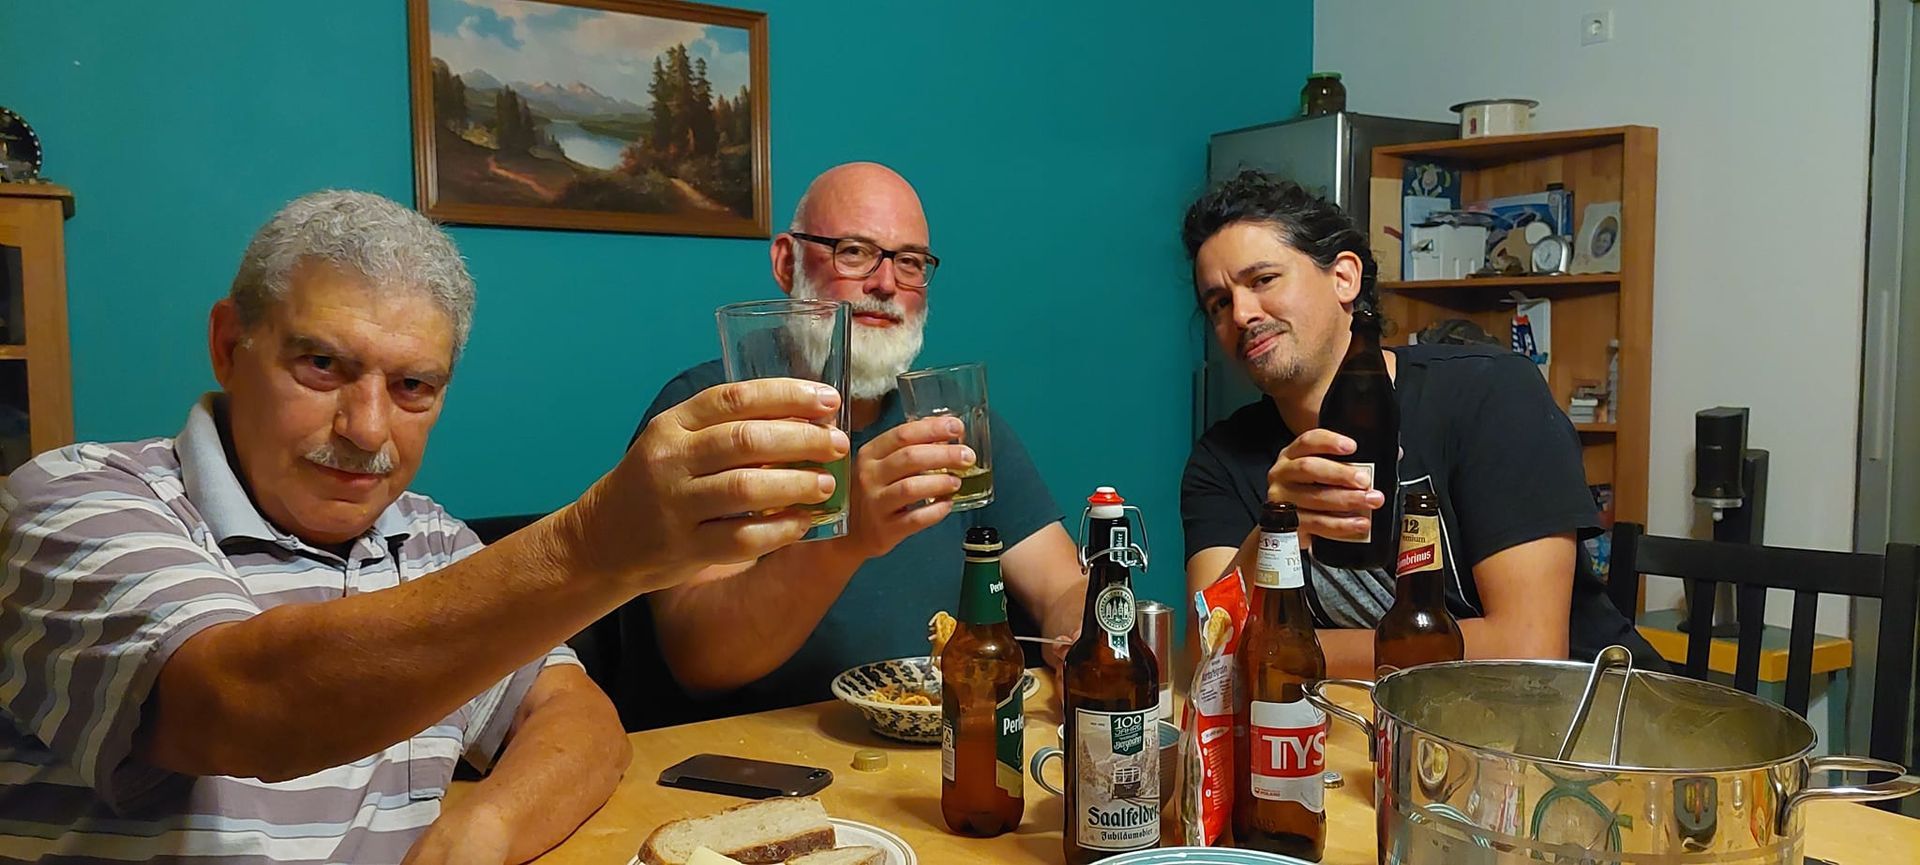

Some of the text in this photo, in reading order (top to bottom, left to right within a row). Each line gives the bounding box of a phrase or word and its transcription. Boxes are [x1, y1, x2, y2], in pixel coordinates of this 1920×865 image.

[1403, 518, 1420, 534] 12
[1113, 714, 1142, 730] 100
[1262, 731, 1326, 770] TYS
